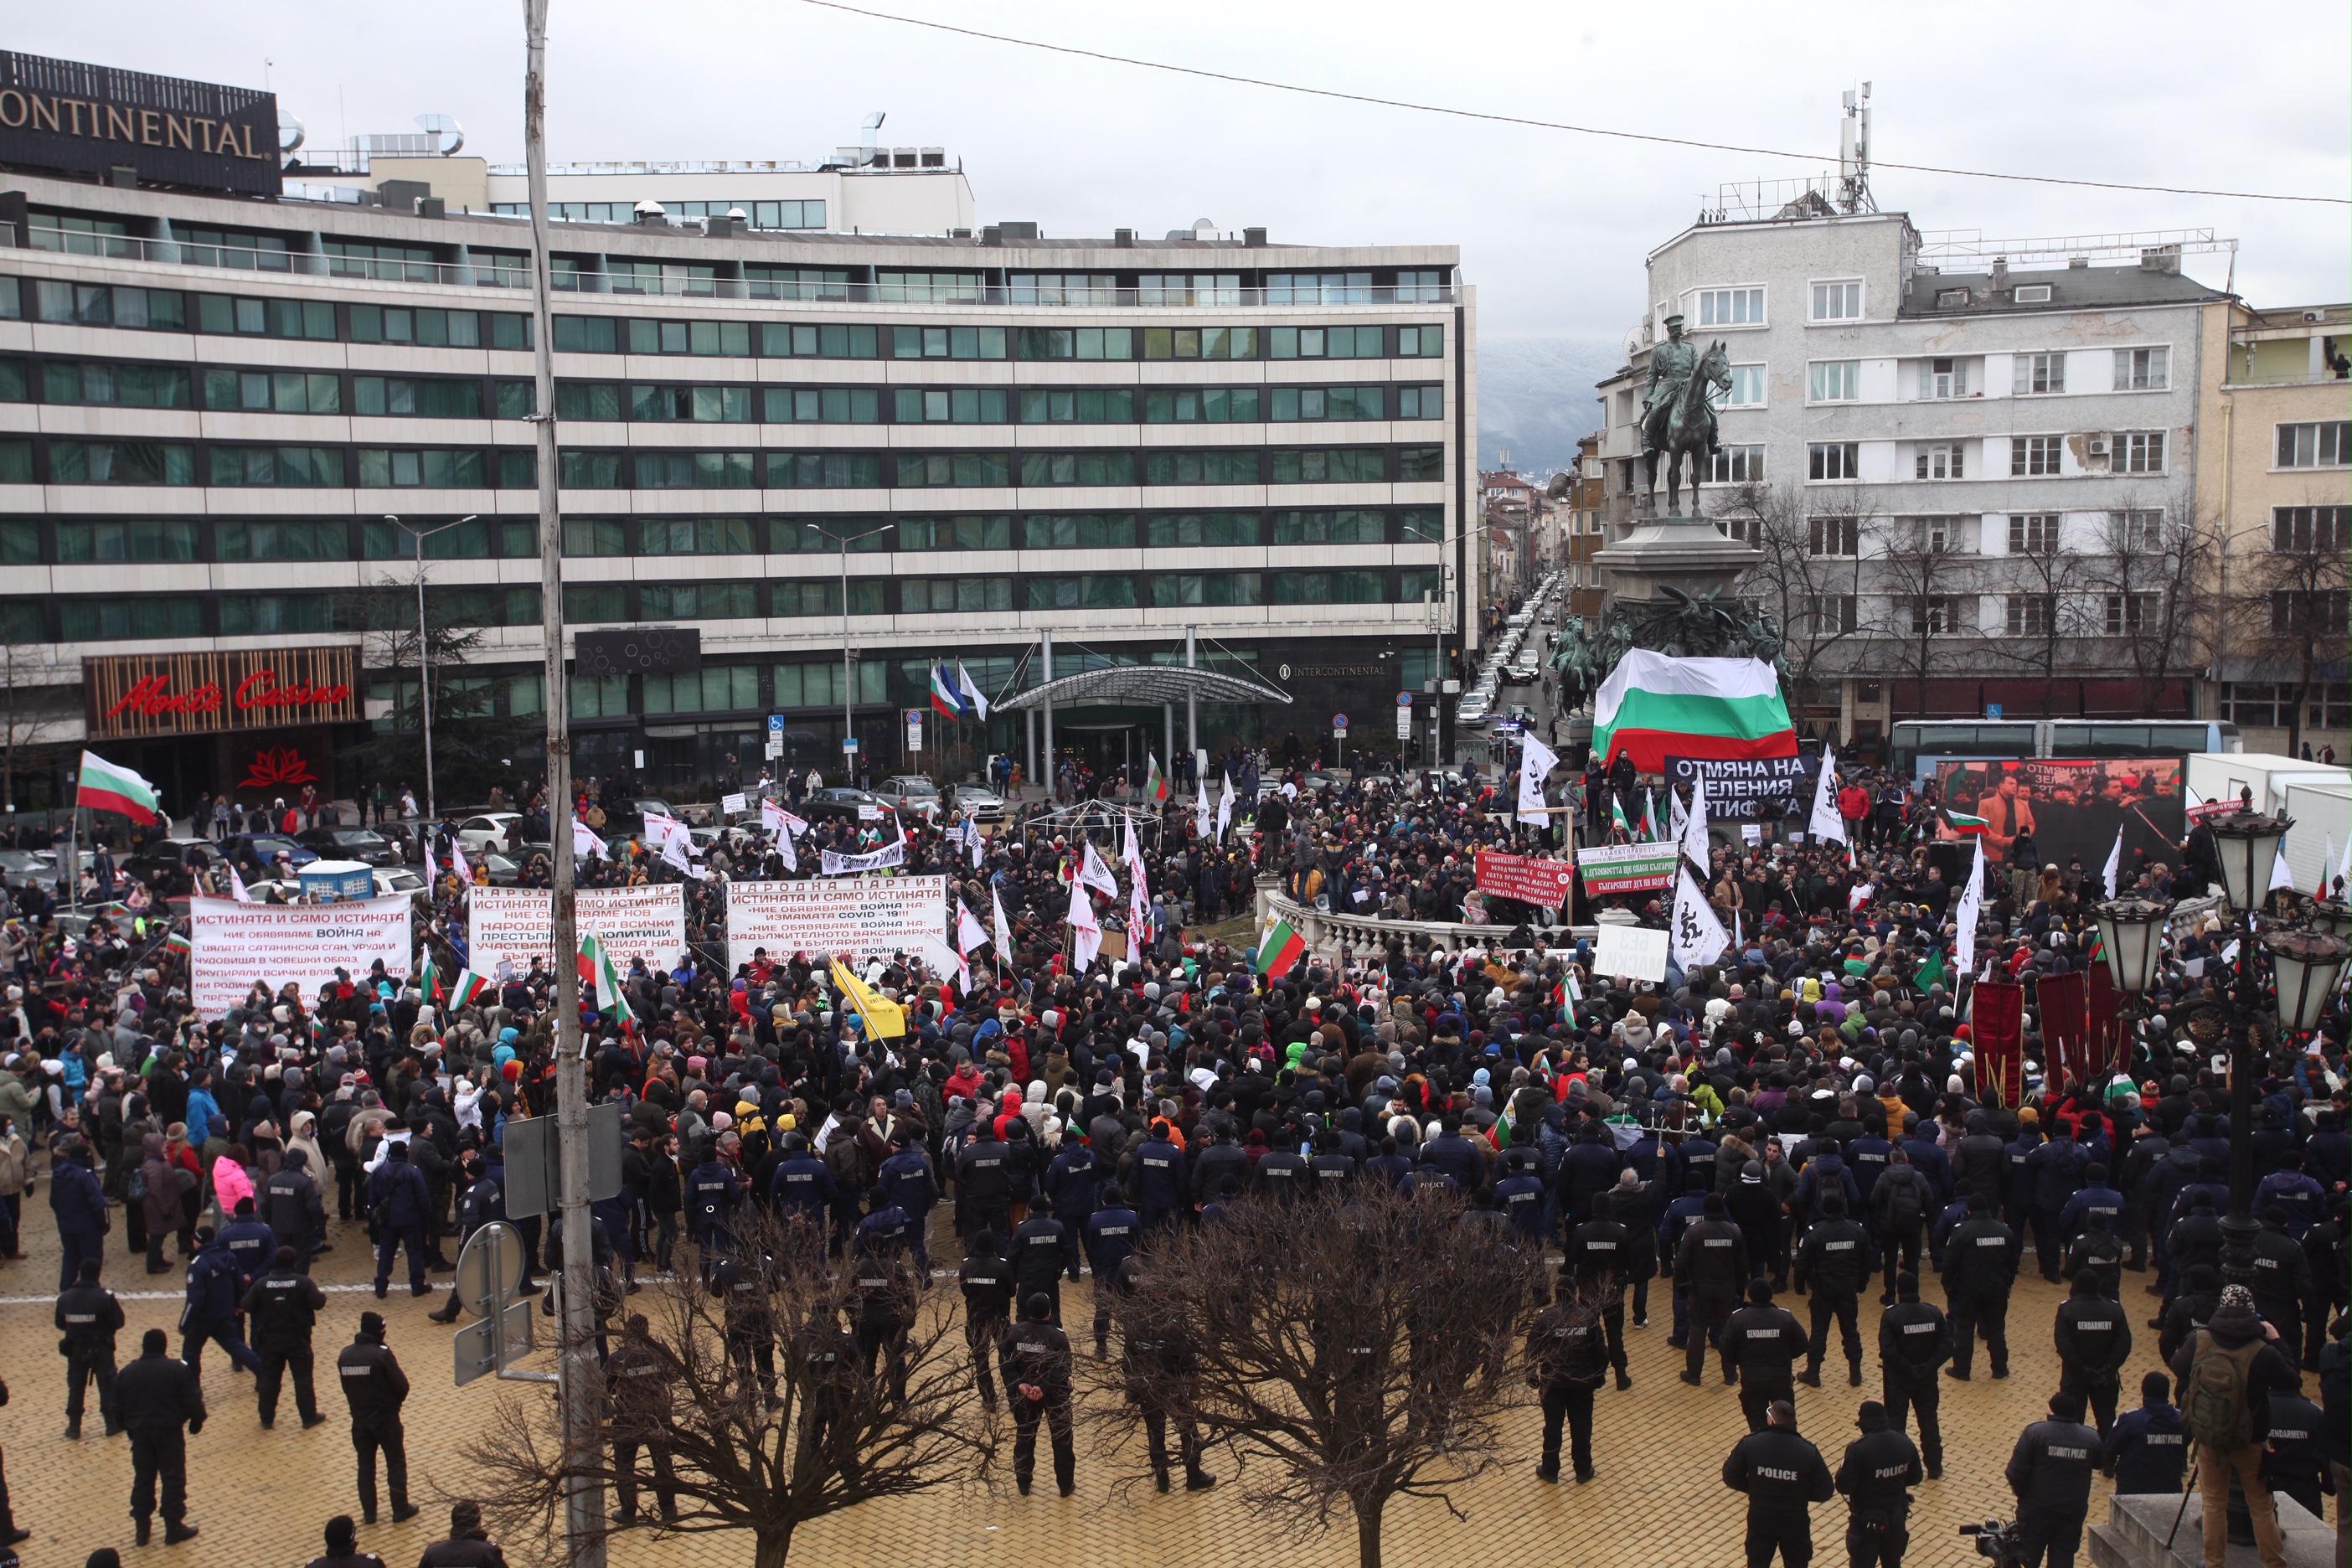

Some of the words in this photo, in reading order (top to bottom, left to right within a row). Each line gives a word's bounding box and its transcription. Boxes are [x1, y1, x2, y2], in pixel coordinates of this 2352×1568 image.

[106, 674, 223, 718] Monte
[235, 669, 350, 709] Casino
[1677, 760, 1769, 777] ОТМЯНА
[1774, 758, 1805, 776] НА
[1527, 859, 1563, 872] ГРАЖДАНСКО
[731, 881, 837, 893] НАРОДНА
[854, 877, 941, 890] ПАРТИЯ
[595, 886, 680, 897] ПАРТИЯ
[732, 894, 805, 904] ИСТИНАТА
[810, 894, 820, 903] И
[823, 892, 864, 902] САМО
[868, 890, 941, 900] ИСТИНАТА
[474, 900, 548, 909] ИСТИНАТА
[575, 899, 606, 909] АМО
[609, 897, 680, 907] ИСТИНАТА
[780, 904, 857, 913] ОБЯВЯВАМЕ
[860, 902, 903, 910] ВОЙНА
[196, 915, 272, 924] ИСТИНАТА
[276, 915, 286, 923] И
[290, 914, 331, 924] САМО
[334, 913, 405, 923] ИСТИНАТА
[504, 910, 534, 919] НИЕ
[624, 908, 651, 917] НОВ
[598, 921, 616, 929] ЗА
[620, 920, 675, 929] ВСИЧКИ
[781, 922, 857, 931] ОБЯВЯВАМЕ
[861, 920, 903, 928] ВОЙНА
[248, 931, 314, 939] ОБЯВЯВАМЕ
[317, 926, 364, 939] ВОЙНА
[731, 930, 850, 940] ЗАДЪЛЖИТЕЛНОТО
[322, 944, 350, 953] СГАН,
[651, 939, 680, 947] НАД
[805, 939, 869, 947] БЪЛГАРИЯ
[606, 949, 642, 959] АРОД
[861, 946, 903, 955] ВОЙНА
[323, 956, 359, 965] ОБРАЗ,
[263, 968, 307, 977] ВСИЧКИ
[1903, 1322, 1936, 1335] GENDARMERY
[2077, 1321, 2112, 1331] GENDARMERY
[1746, 1328, 1780, 1338] GENDARMERY
[2147, 1434, 2168, 1445] SECURITY
[2168, 1434, 2183, 1445] POLICE
[2048, 1446, 2071, 1458] SECURITY
[2071, 1448, 2088, 1460] POLICE
[1757, 1466, 1798, 1481] POLICE
[1875, 1462, 1910, 1479] POLICE
